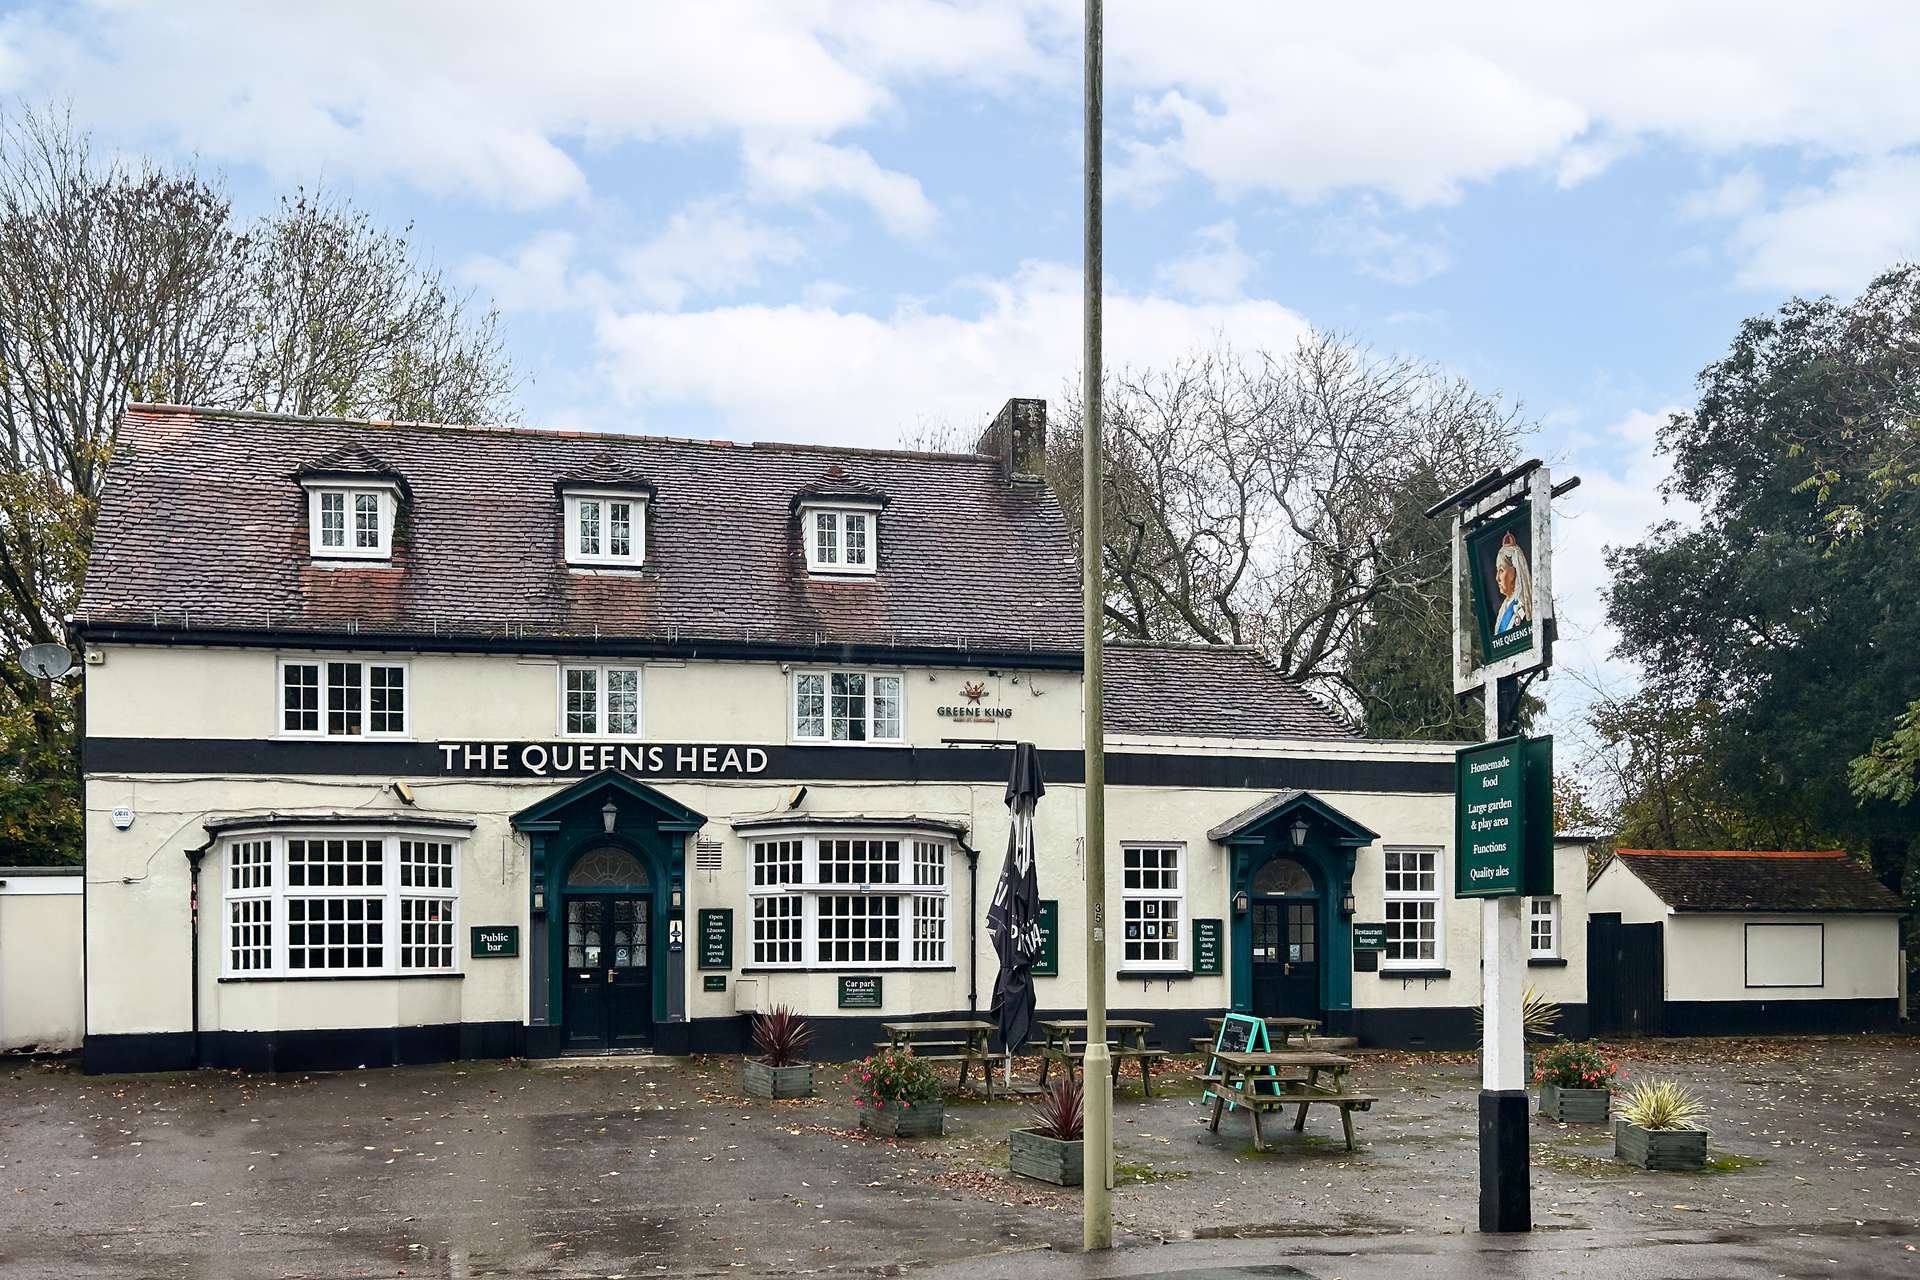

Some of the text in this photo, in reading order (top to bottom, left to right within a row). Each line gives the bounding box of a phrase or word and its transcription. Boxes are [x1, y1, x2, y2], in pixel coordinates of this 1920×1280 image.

[1492, 637, 1504, 648] THE
[1504, 627, 1528, 645] QUEENS
[937, 706, 1012, 719] GREENE KING
[438, 744, 768, 775] THE QUEENS HEAD
[1470, 756, 1511, 774] Homemade
[1482, 774, 1499, 788] food
[1468, 797, 1513, 815] Large garden
[1470, 817, 1509, 832] & play area
[1473, 842, 1507, 855] Functions
[1470, 864, 1510, 881] Quality ales
[480, 933, 509, 942] Public
[1354, 928, 1383, 936] Restaurant
[487, 942, 502, 951] bar
[1359, 936, 1378, 945] lounge
[845, 980, 876, 989] Car park
